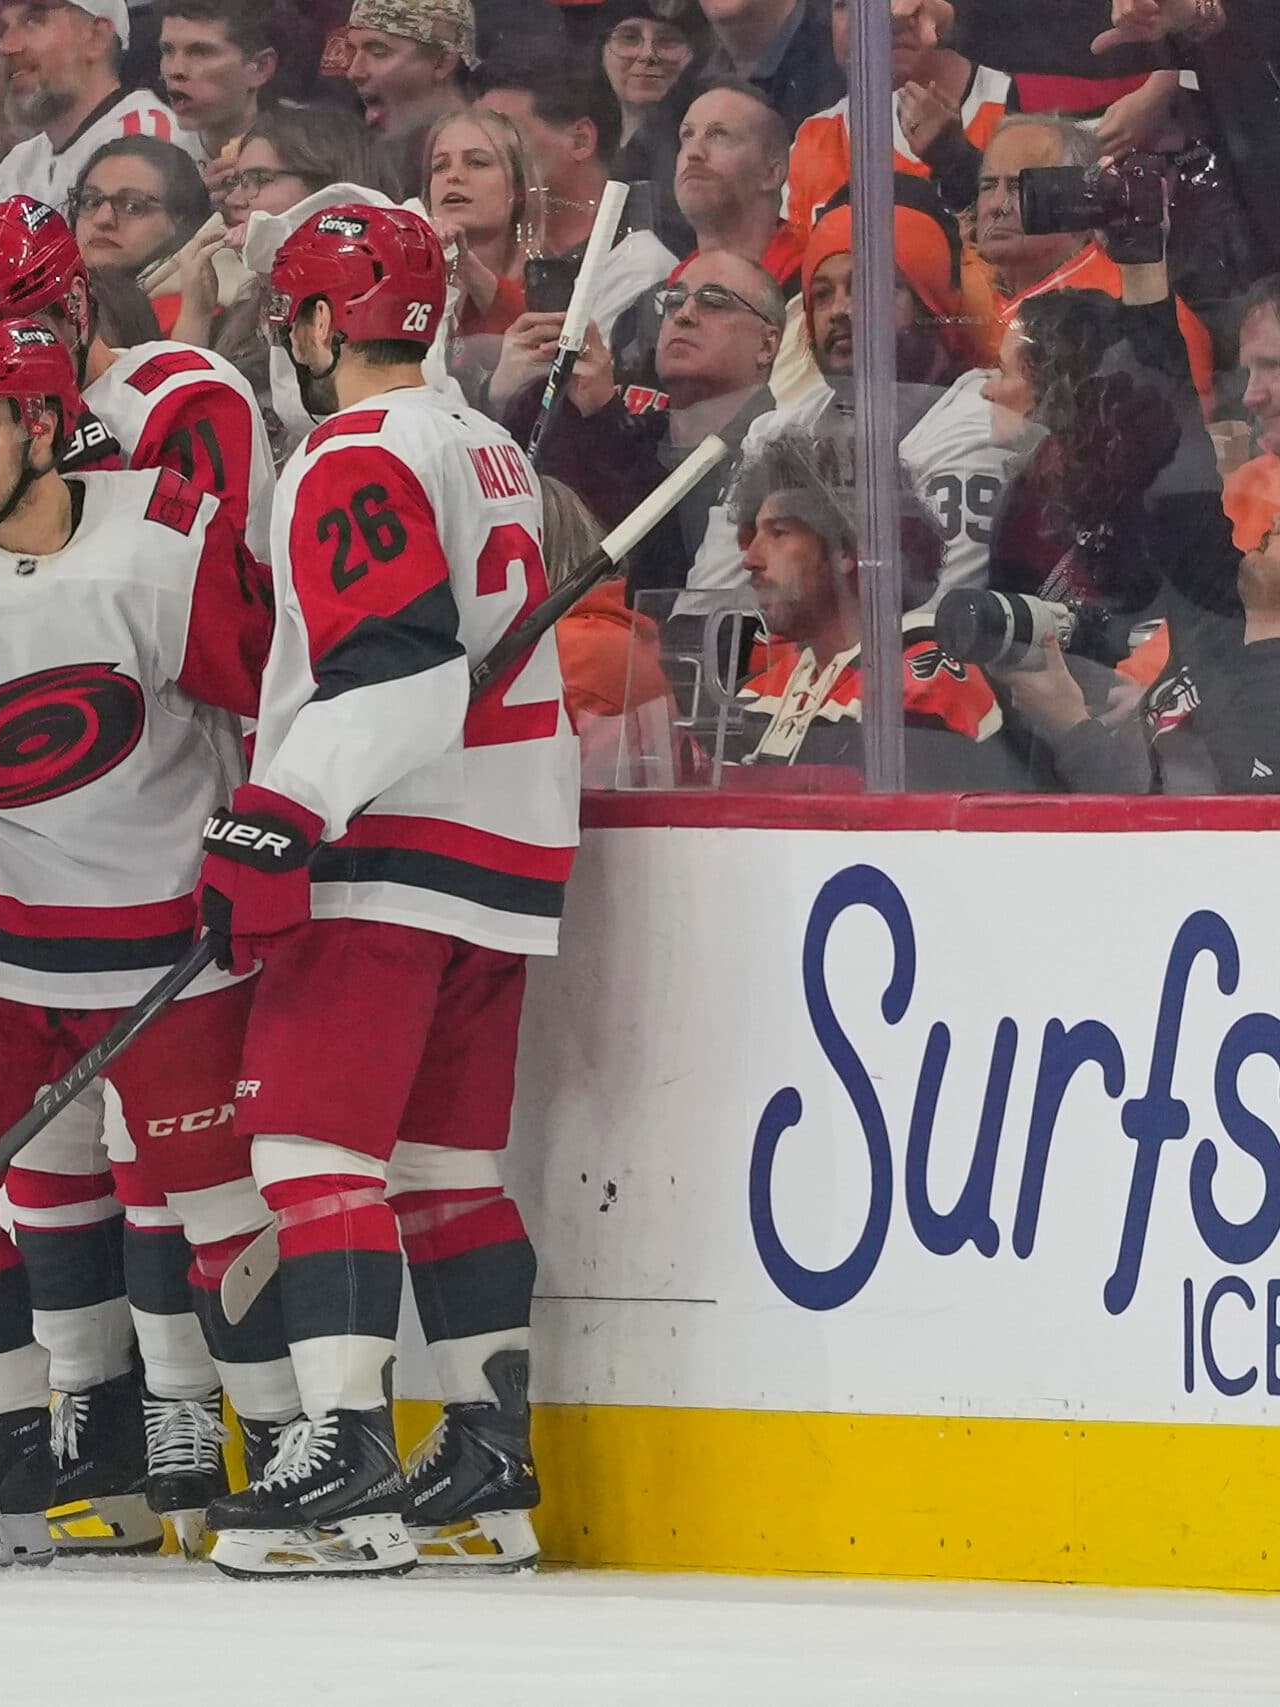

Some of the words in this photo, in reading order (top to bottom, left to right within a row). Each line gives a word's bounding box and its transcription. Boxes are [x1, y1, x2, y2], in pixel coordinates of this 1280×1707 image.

[318, 216, 362, 234] Lenovo
[402, 301, 433, 332] 26
[925, 474, 1003, 544] 39
[316, 482, 408, 594] 26
